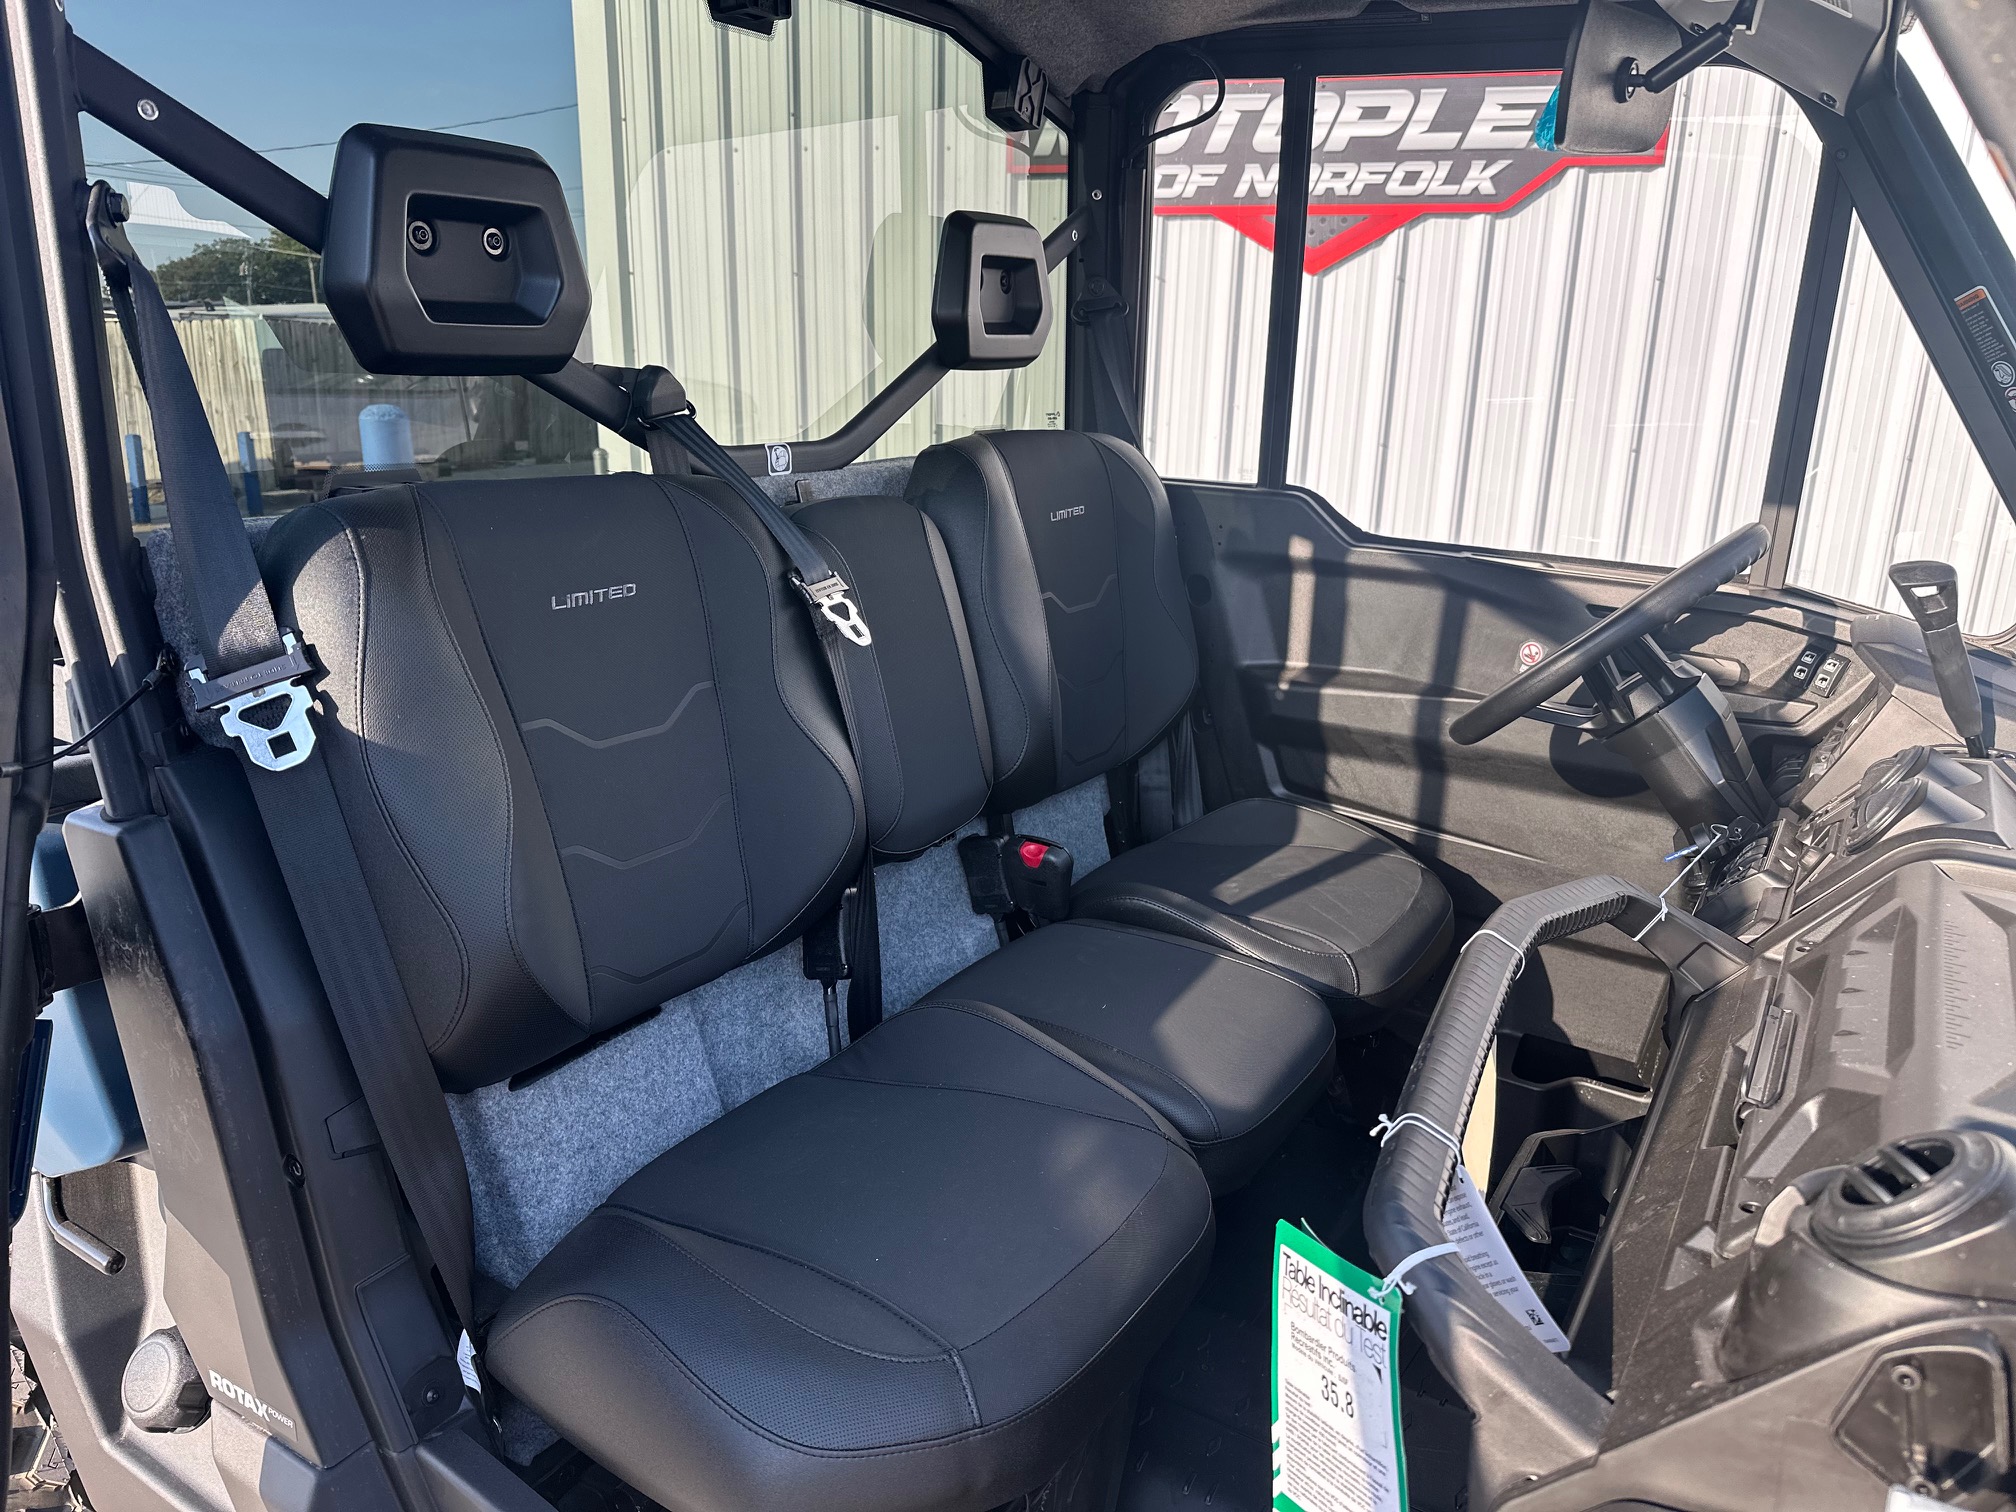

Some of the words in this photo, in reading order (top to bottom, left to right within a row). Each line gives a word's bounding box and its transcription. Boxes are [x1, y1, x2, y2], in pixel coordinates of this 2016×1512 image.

[1154, 164, 1227, 198] OF
[1050, 505, 1085, 521] LIMITED
[551, 583, 637, 610] LIMITED
[1283, 1251, 1315, 1293] Table
[1318, 1275, 1387, 1341] Inclinable
[1282, 1276, 1332, 1331] Résultat
[1334, 1315, 1353, 1345] du
[1354, 1324, 1387, 1369] Test
[209, 1369, 270, 1422] ROTAX
[268, 1407, 294, 1428] POWER
[1321, 1374, 1354, 1419] 35.8
